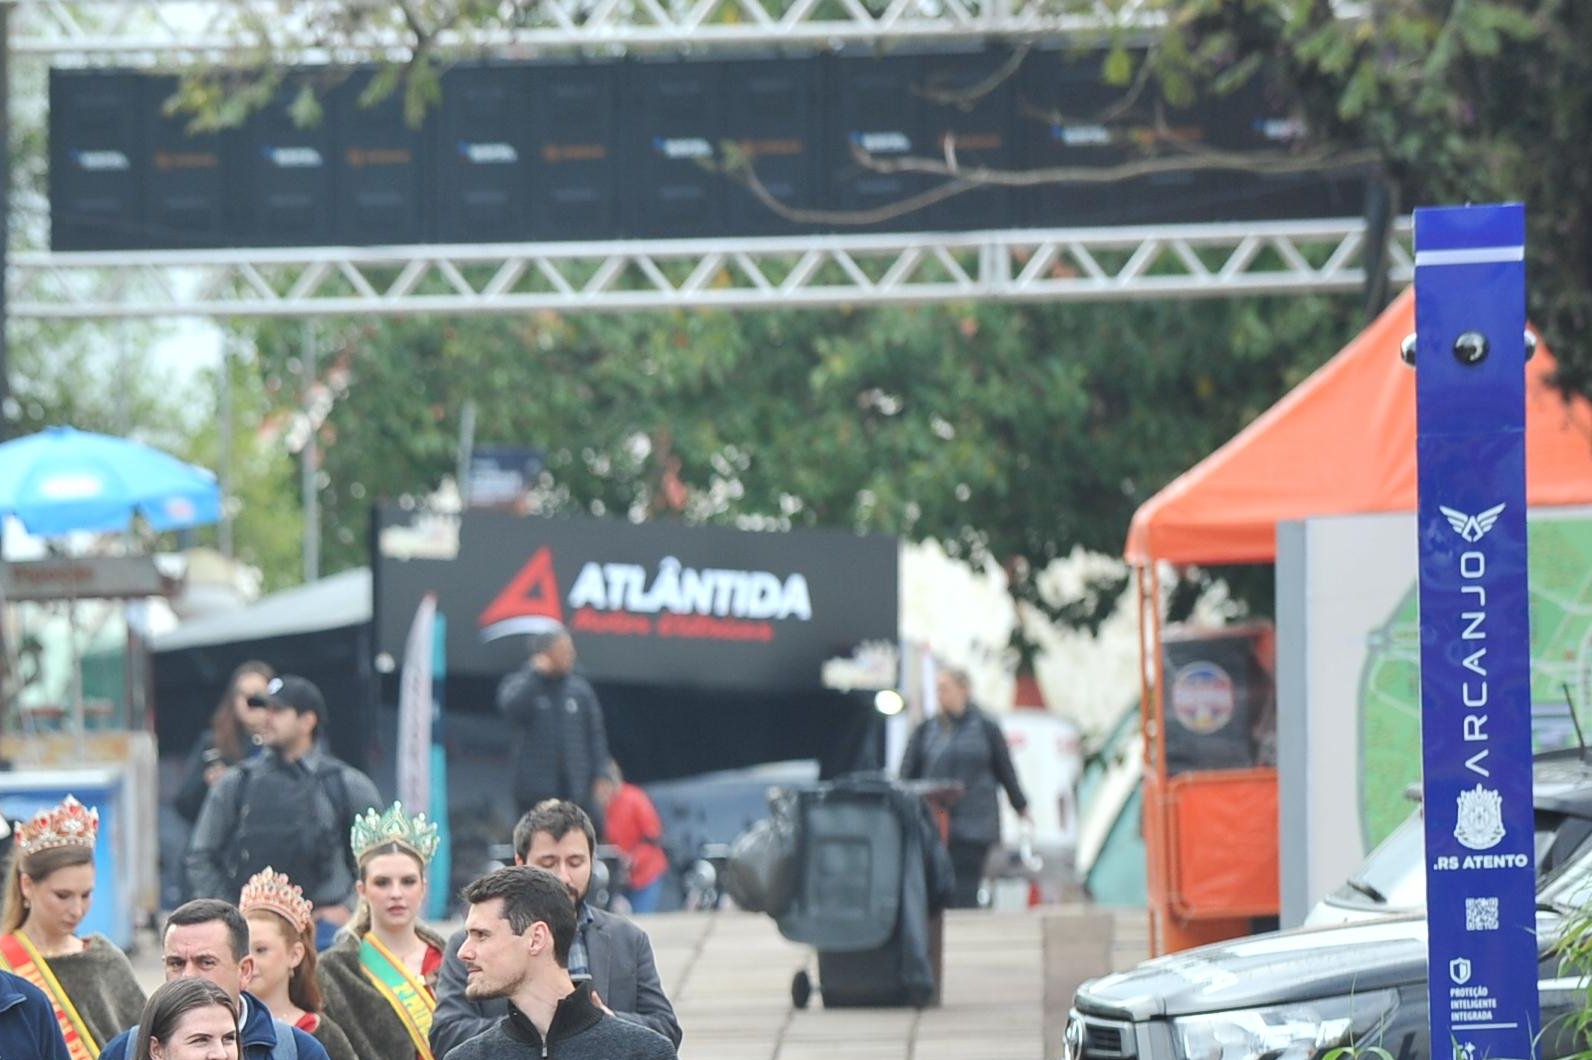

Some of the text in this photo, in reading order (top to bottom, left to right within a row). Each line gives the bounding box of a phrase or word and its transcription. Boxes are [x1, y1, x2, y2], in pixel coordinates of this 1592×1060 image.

[569, 556, 812, 620] ATLÂNTIDA
[1460, 551, 1489, 777] ARCANJO
[1463, 854, 1528, 869] ATENTO
[1450, 985, 1488, 998] PROTEÇÃO
[1451, 998, 1497, 1009] INTELIGENTE
[1451, 1010, 1493, 1021] INTEGRADA
